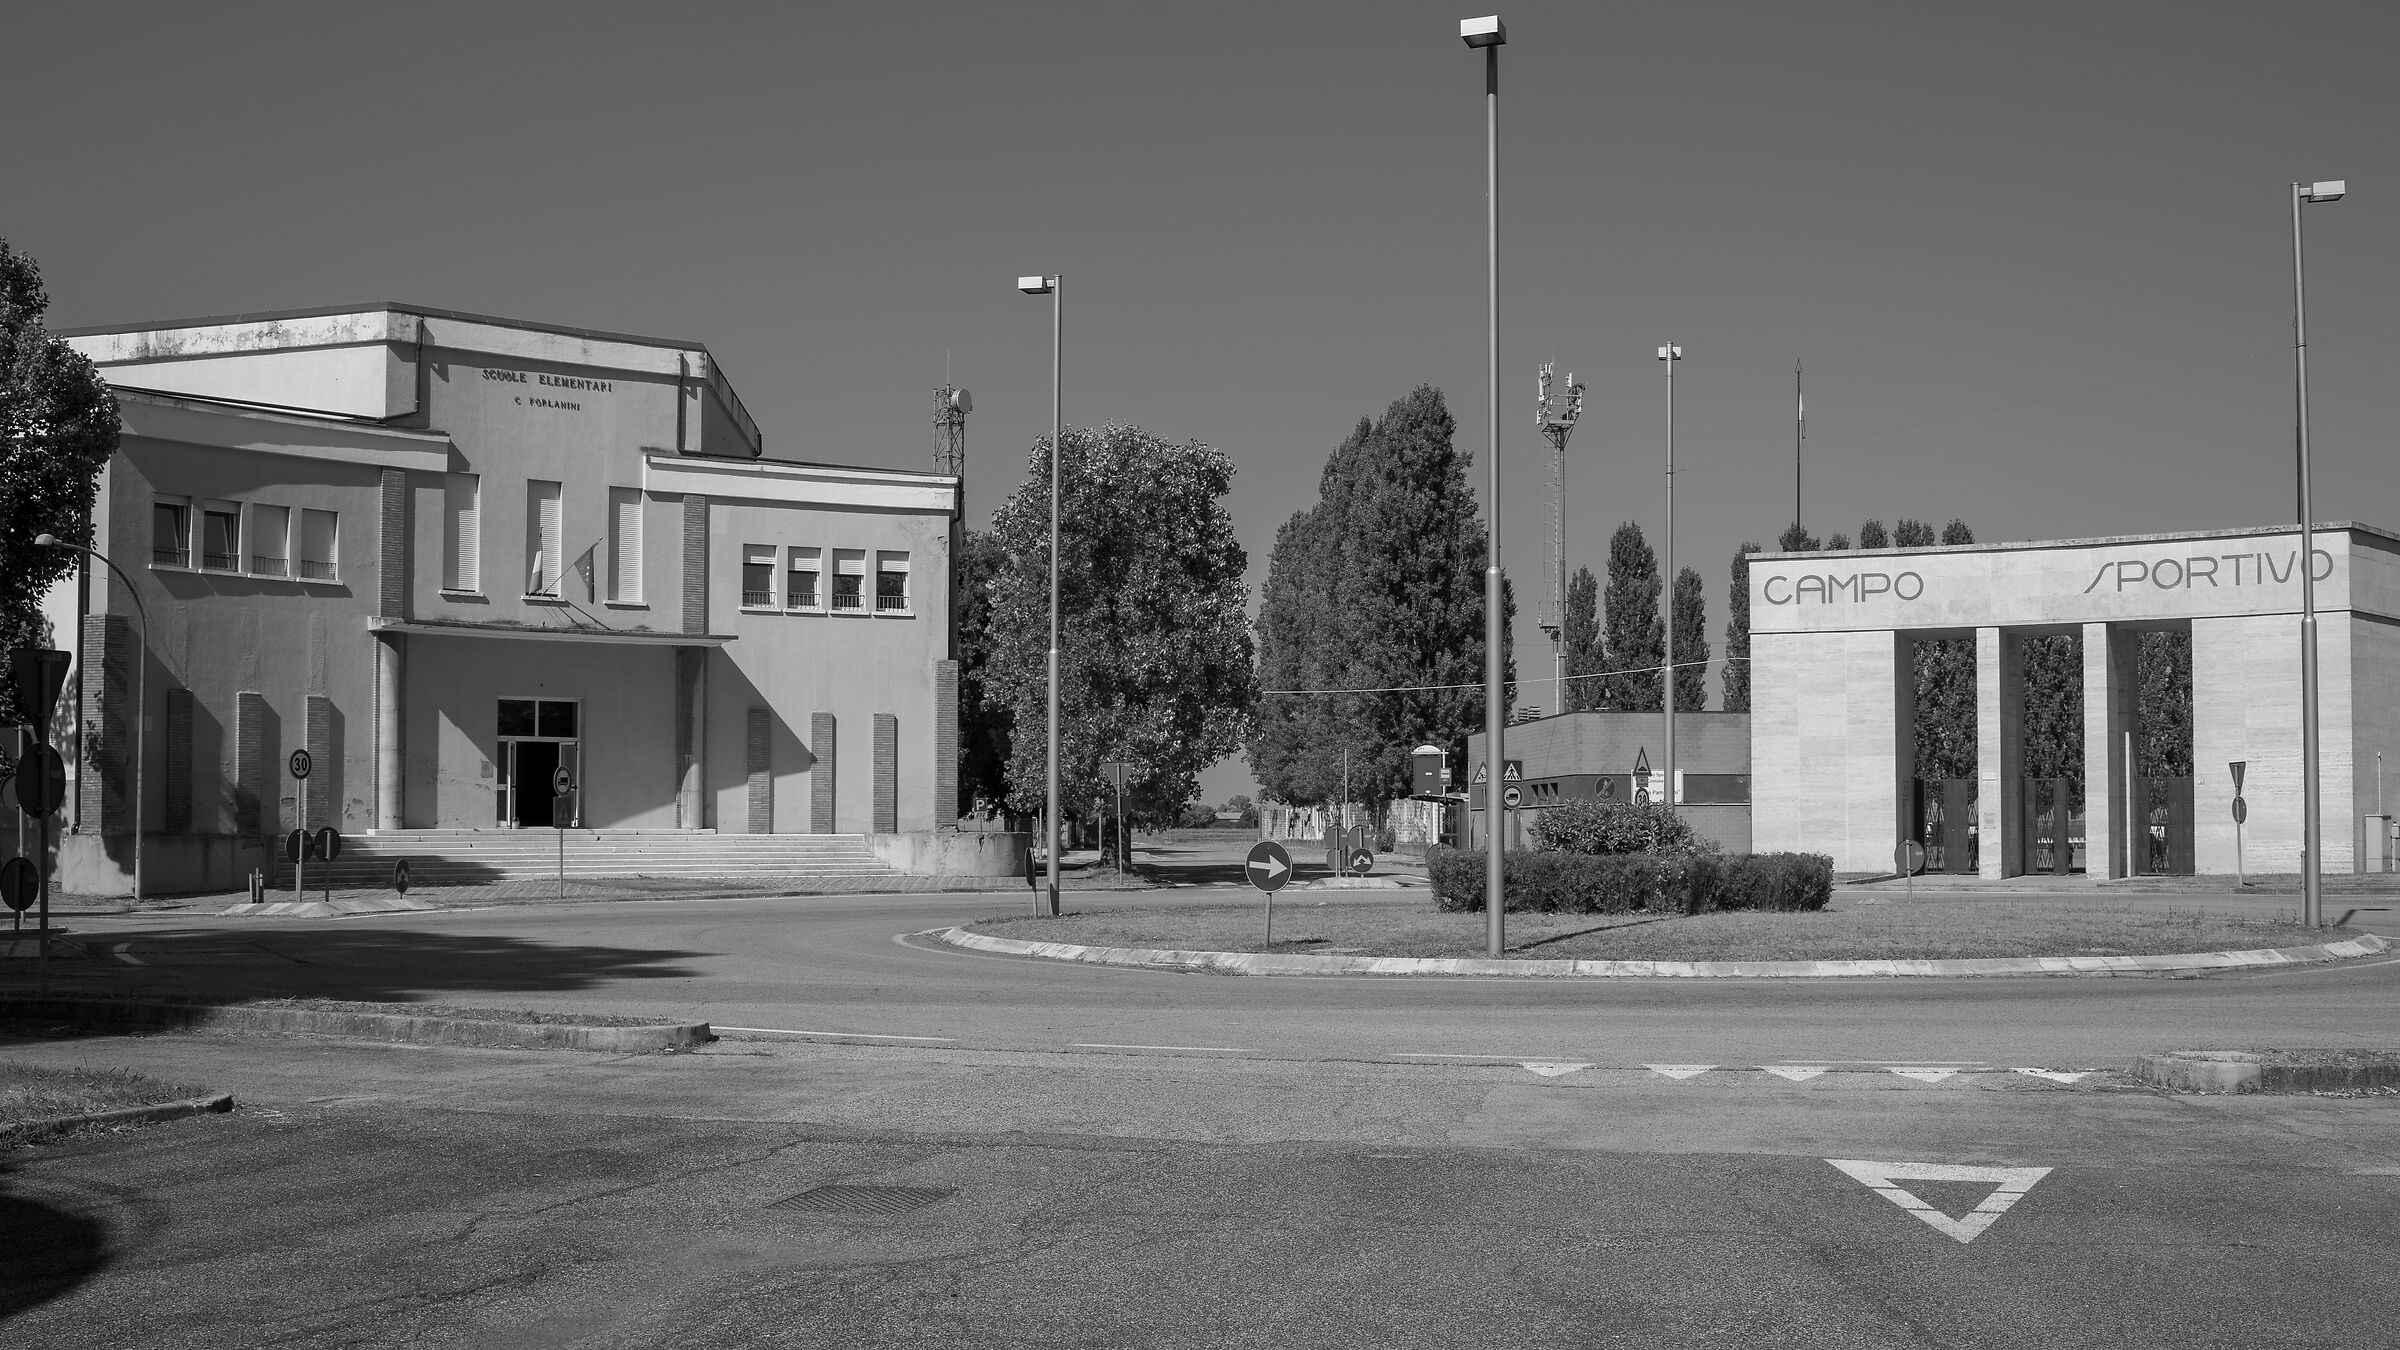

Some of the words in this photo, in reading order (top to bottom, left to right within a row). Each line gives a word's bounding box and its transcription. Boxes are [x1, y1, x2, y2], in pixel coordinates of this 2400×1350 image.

[482, 369, 527, 383] SCUOLE
[539, 374, 612, 392] ELEMENTARI
[529, 397, 581, 411] FORLANINI
[1764, 572, 1924, 605] CAMPO
[2083, 549, 2334, 594] SPORTIVO
[294, 757, 308, 772] 30
[976, 799, 985, 811] P
